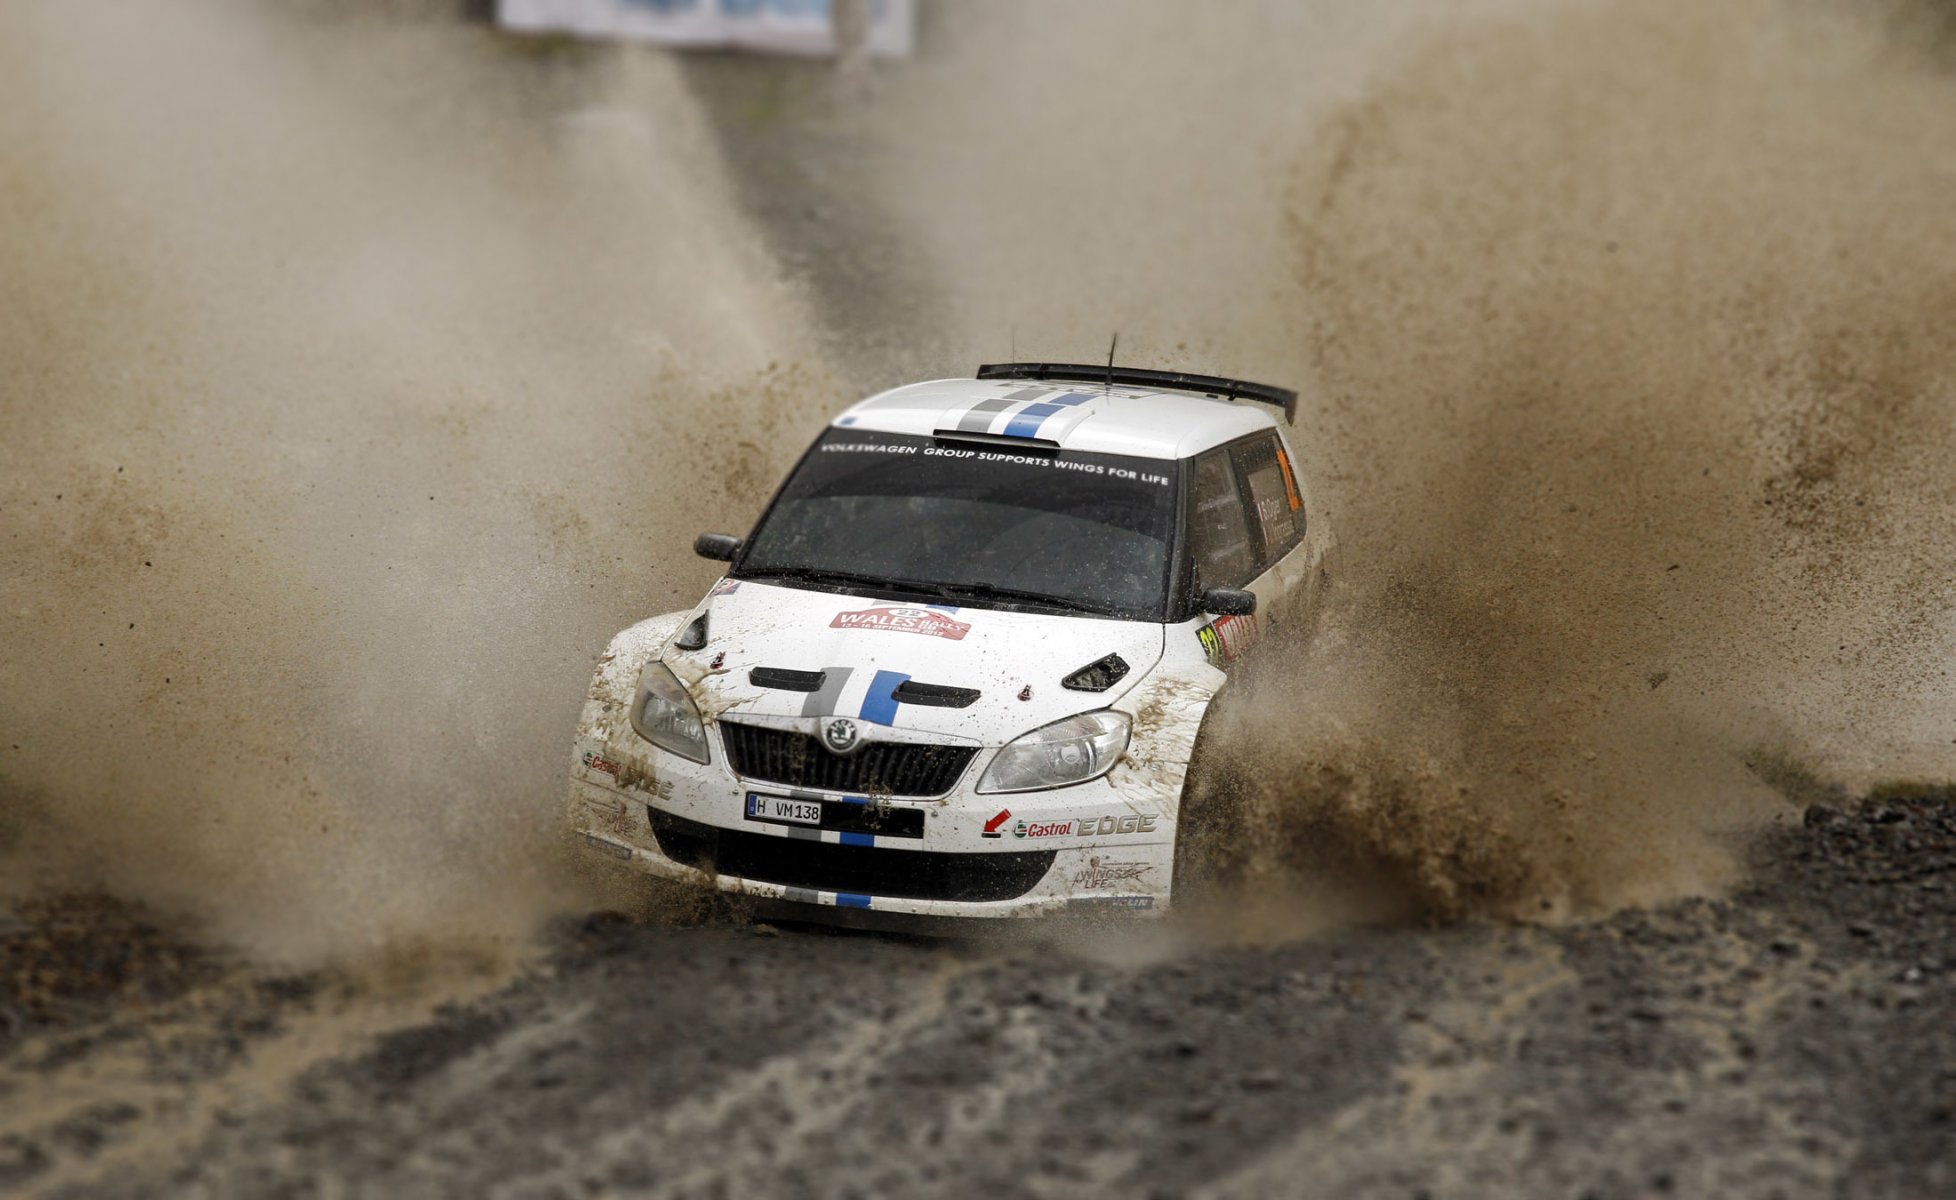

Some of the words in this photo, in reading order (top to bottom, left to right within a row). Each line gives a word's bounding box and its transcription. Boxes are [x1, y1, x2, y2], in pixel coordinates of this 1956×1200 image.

[821, 443, 918, 454] VOLKSWAGEN
[924, 447, 975, 459] GROUP
[977, 452, 1050, 467] SUPPORTS
[1054, 459, 1105, 475] WINGS
[1108, 467, 1138, 480] FOR
[1141, 472, 1169, 486] LIFE
[840, 614, 918, 627] WALES
[757, 800, 766, 814] H
[1027, 821, 1072, 837] Castrol
[1076, 813, 1160, 837] EDGE
[1084, 878, 1109, 889] LIFE
